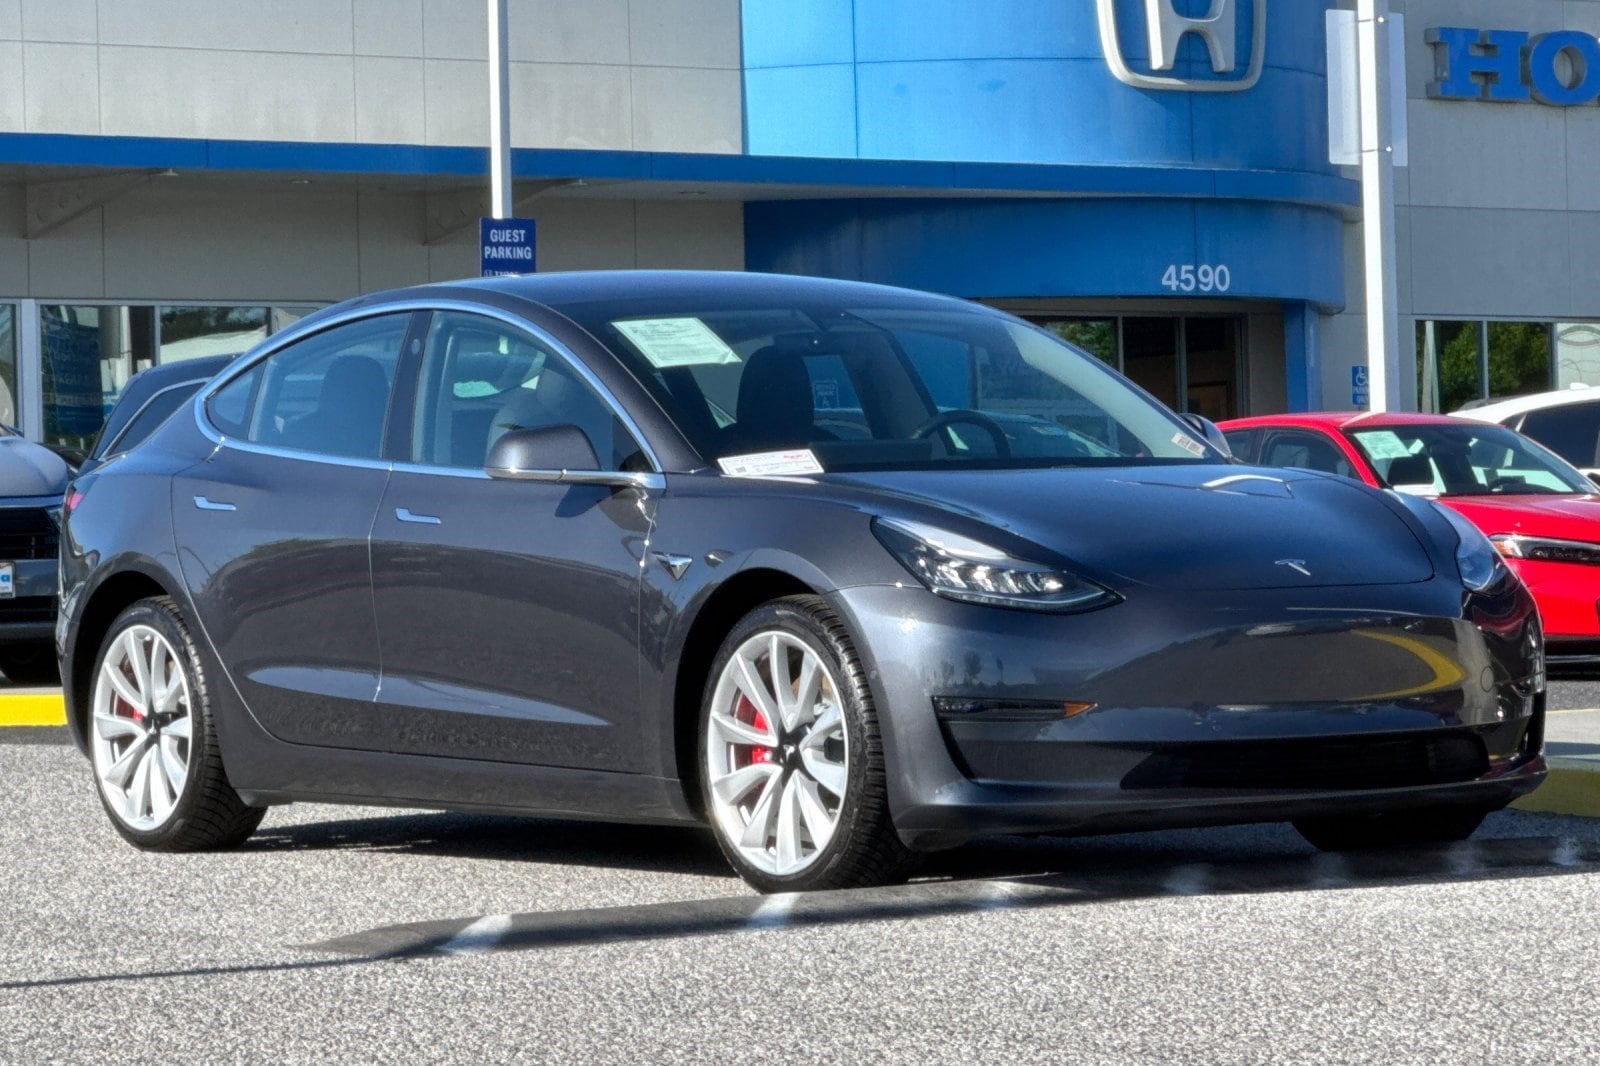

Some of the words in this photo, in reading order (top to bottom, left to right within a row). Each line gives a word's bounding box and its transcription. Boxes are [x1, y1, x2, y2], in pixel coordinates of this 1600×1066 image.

[490, 229, 526, 242] GUEST
[484, 246, 532, 259] PARKING
[1161, 264, 1230, 292] 4590
